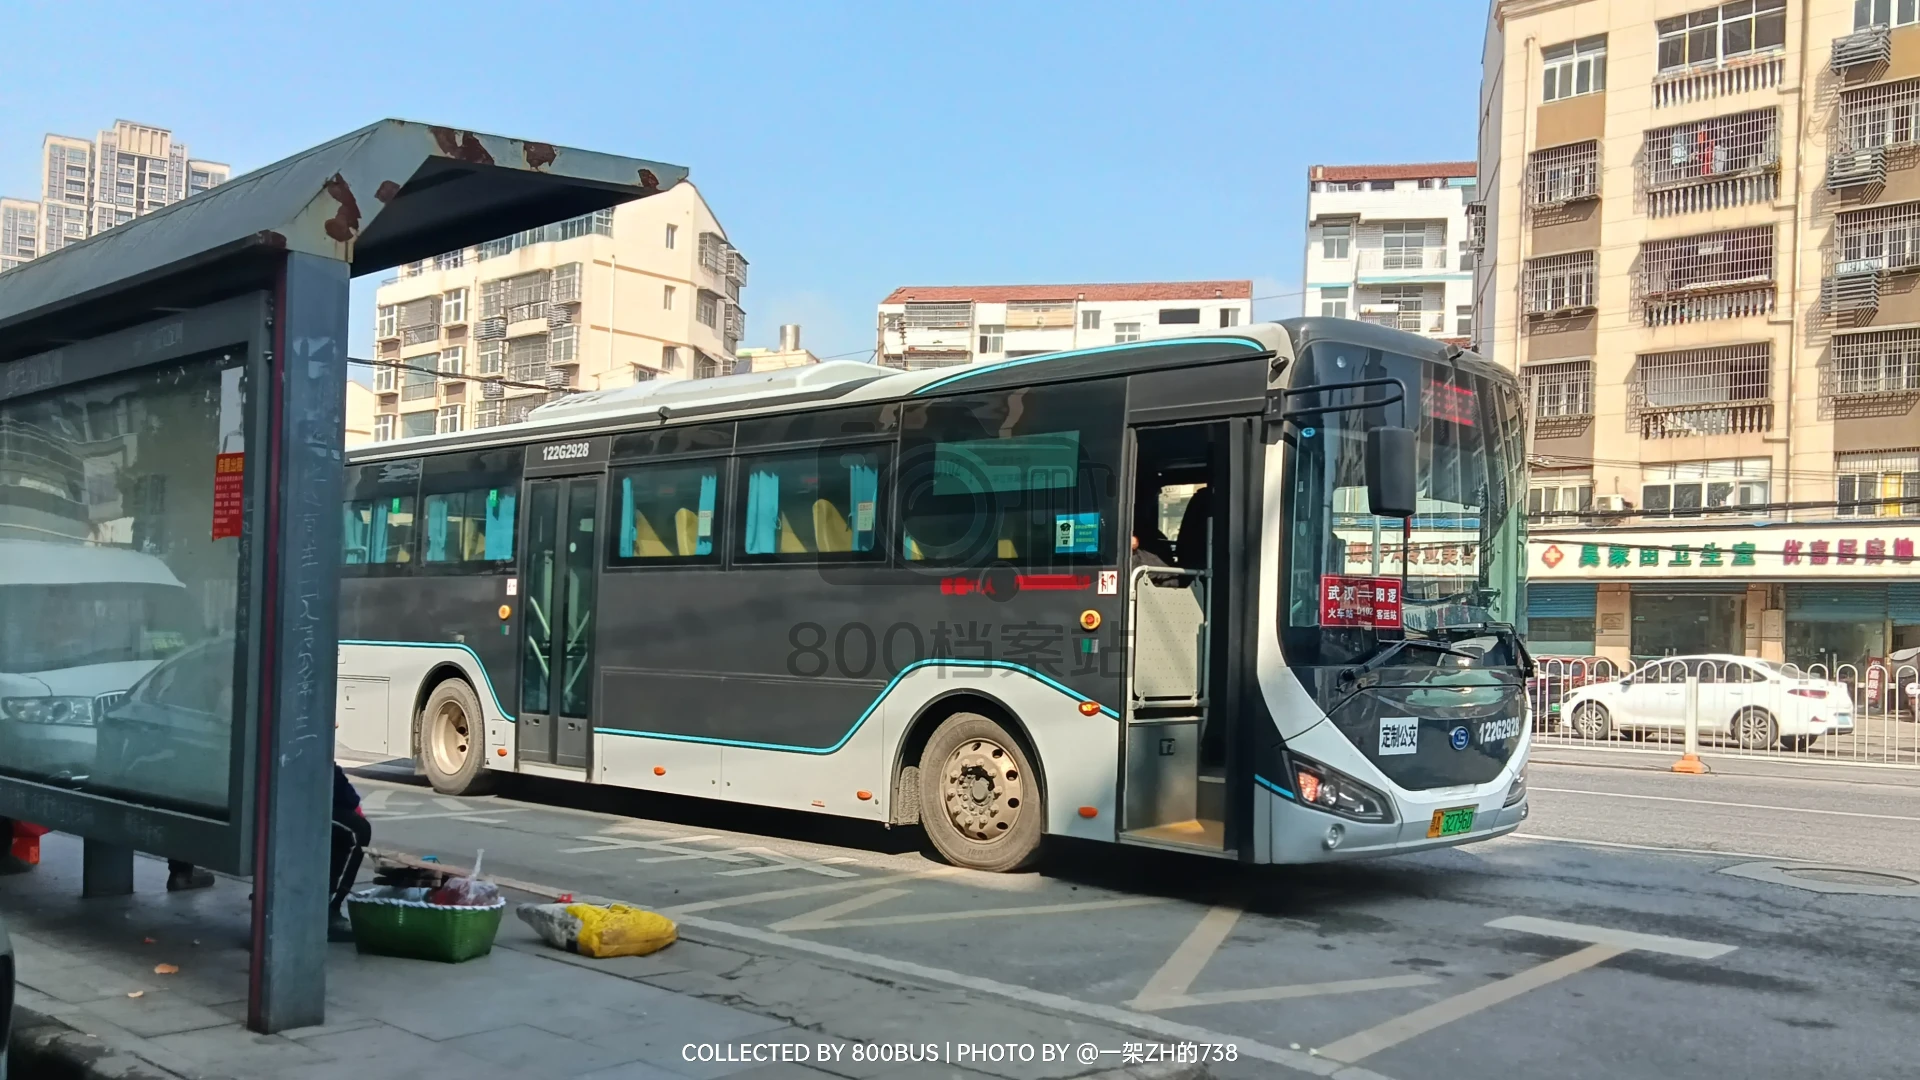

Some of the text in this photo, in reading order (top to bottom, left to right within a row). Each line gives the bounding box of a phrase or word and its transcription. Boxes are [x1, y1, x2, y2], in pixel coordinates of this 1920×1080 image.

[543, 442, 590, 461] 122G2928
[1328, 585, 1398, 603] 武汉 阳逻
[1328, 608, 1354, 619] 火车站
[1376, 608, 1398, 621] 客运站
[1381, 723, 1418, 748] 定制公交
[1479, 716, 1520, 745] 122G2928
